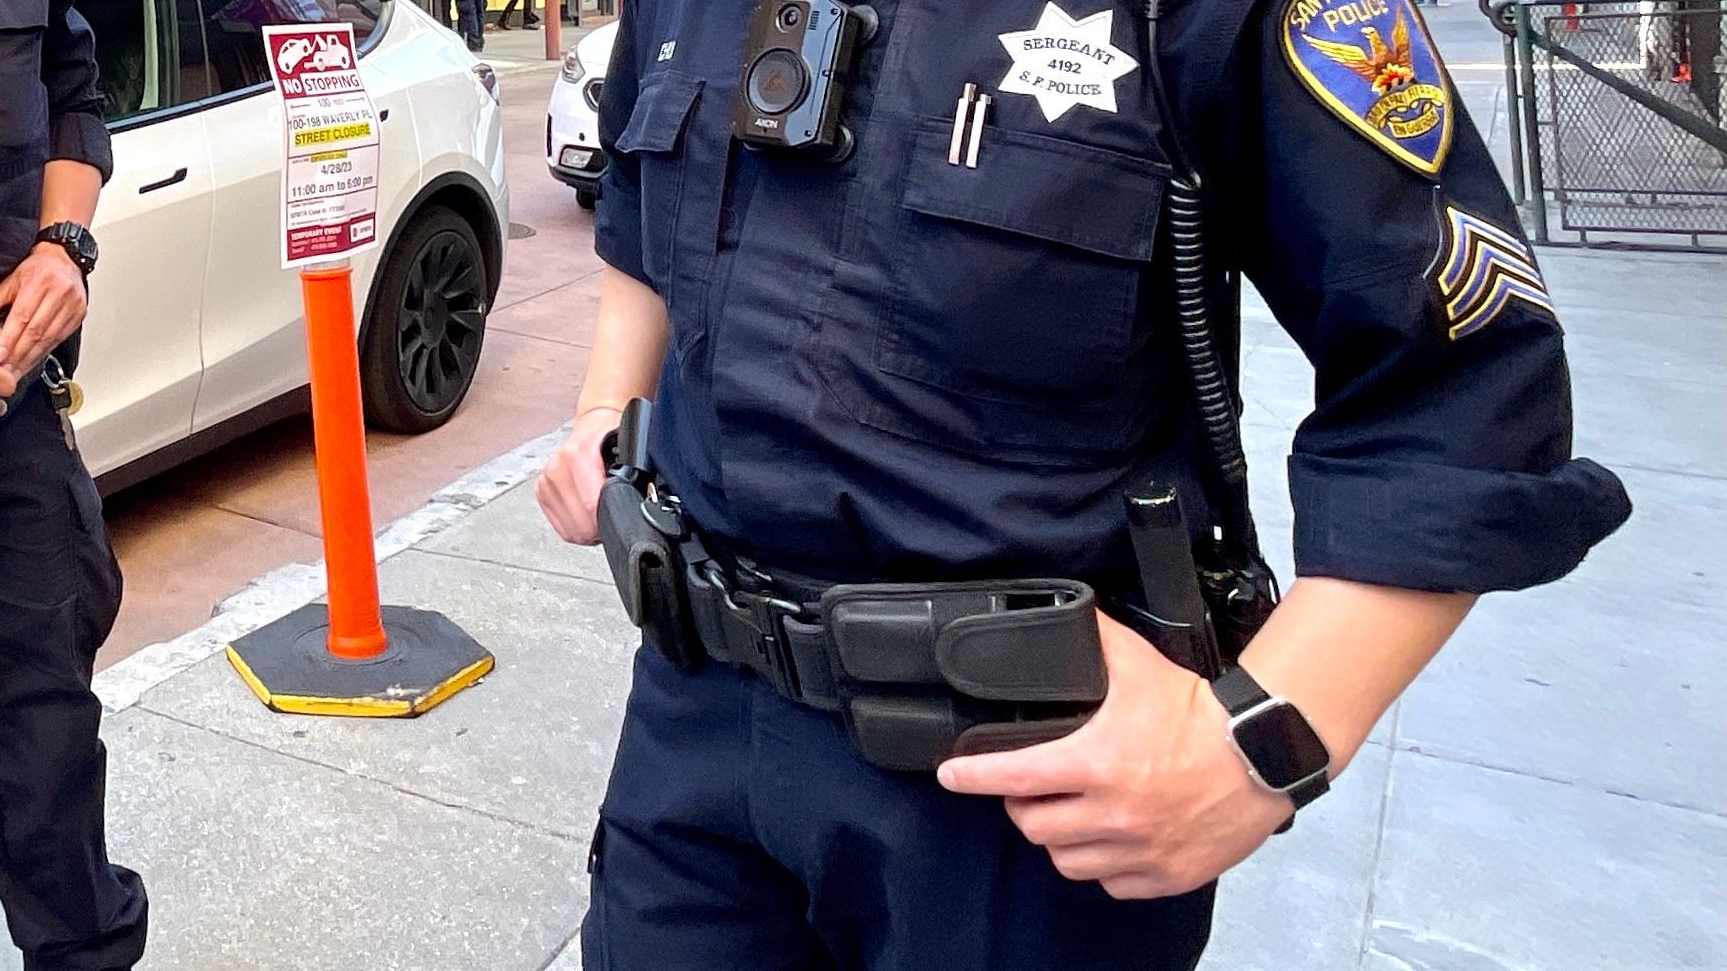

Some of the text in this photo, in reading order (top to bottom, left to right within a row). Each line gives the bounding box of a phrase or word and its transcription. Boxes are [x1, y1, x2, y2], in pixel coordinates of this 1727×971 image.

[1023, 37, 1116, 66] SERGEANT
[1047, 59, 1082, 75] 4192
[282, 74, 360, 95] NO STOPPING
[1047, 79, 1103, 96] POLICE
[288, 109, 373, 131] 100-198 WAVERLY PL
[295, 123, 371, 145] STREET CLOSURE
[292, 184, 316, 197] 11:00
[319, 183, 335, 193] am
[337, 180, 346, 191] to
